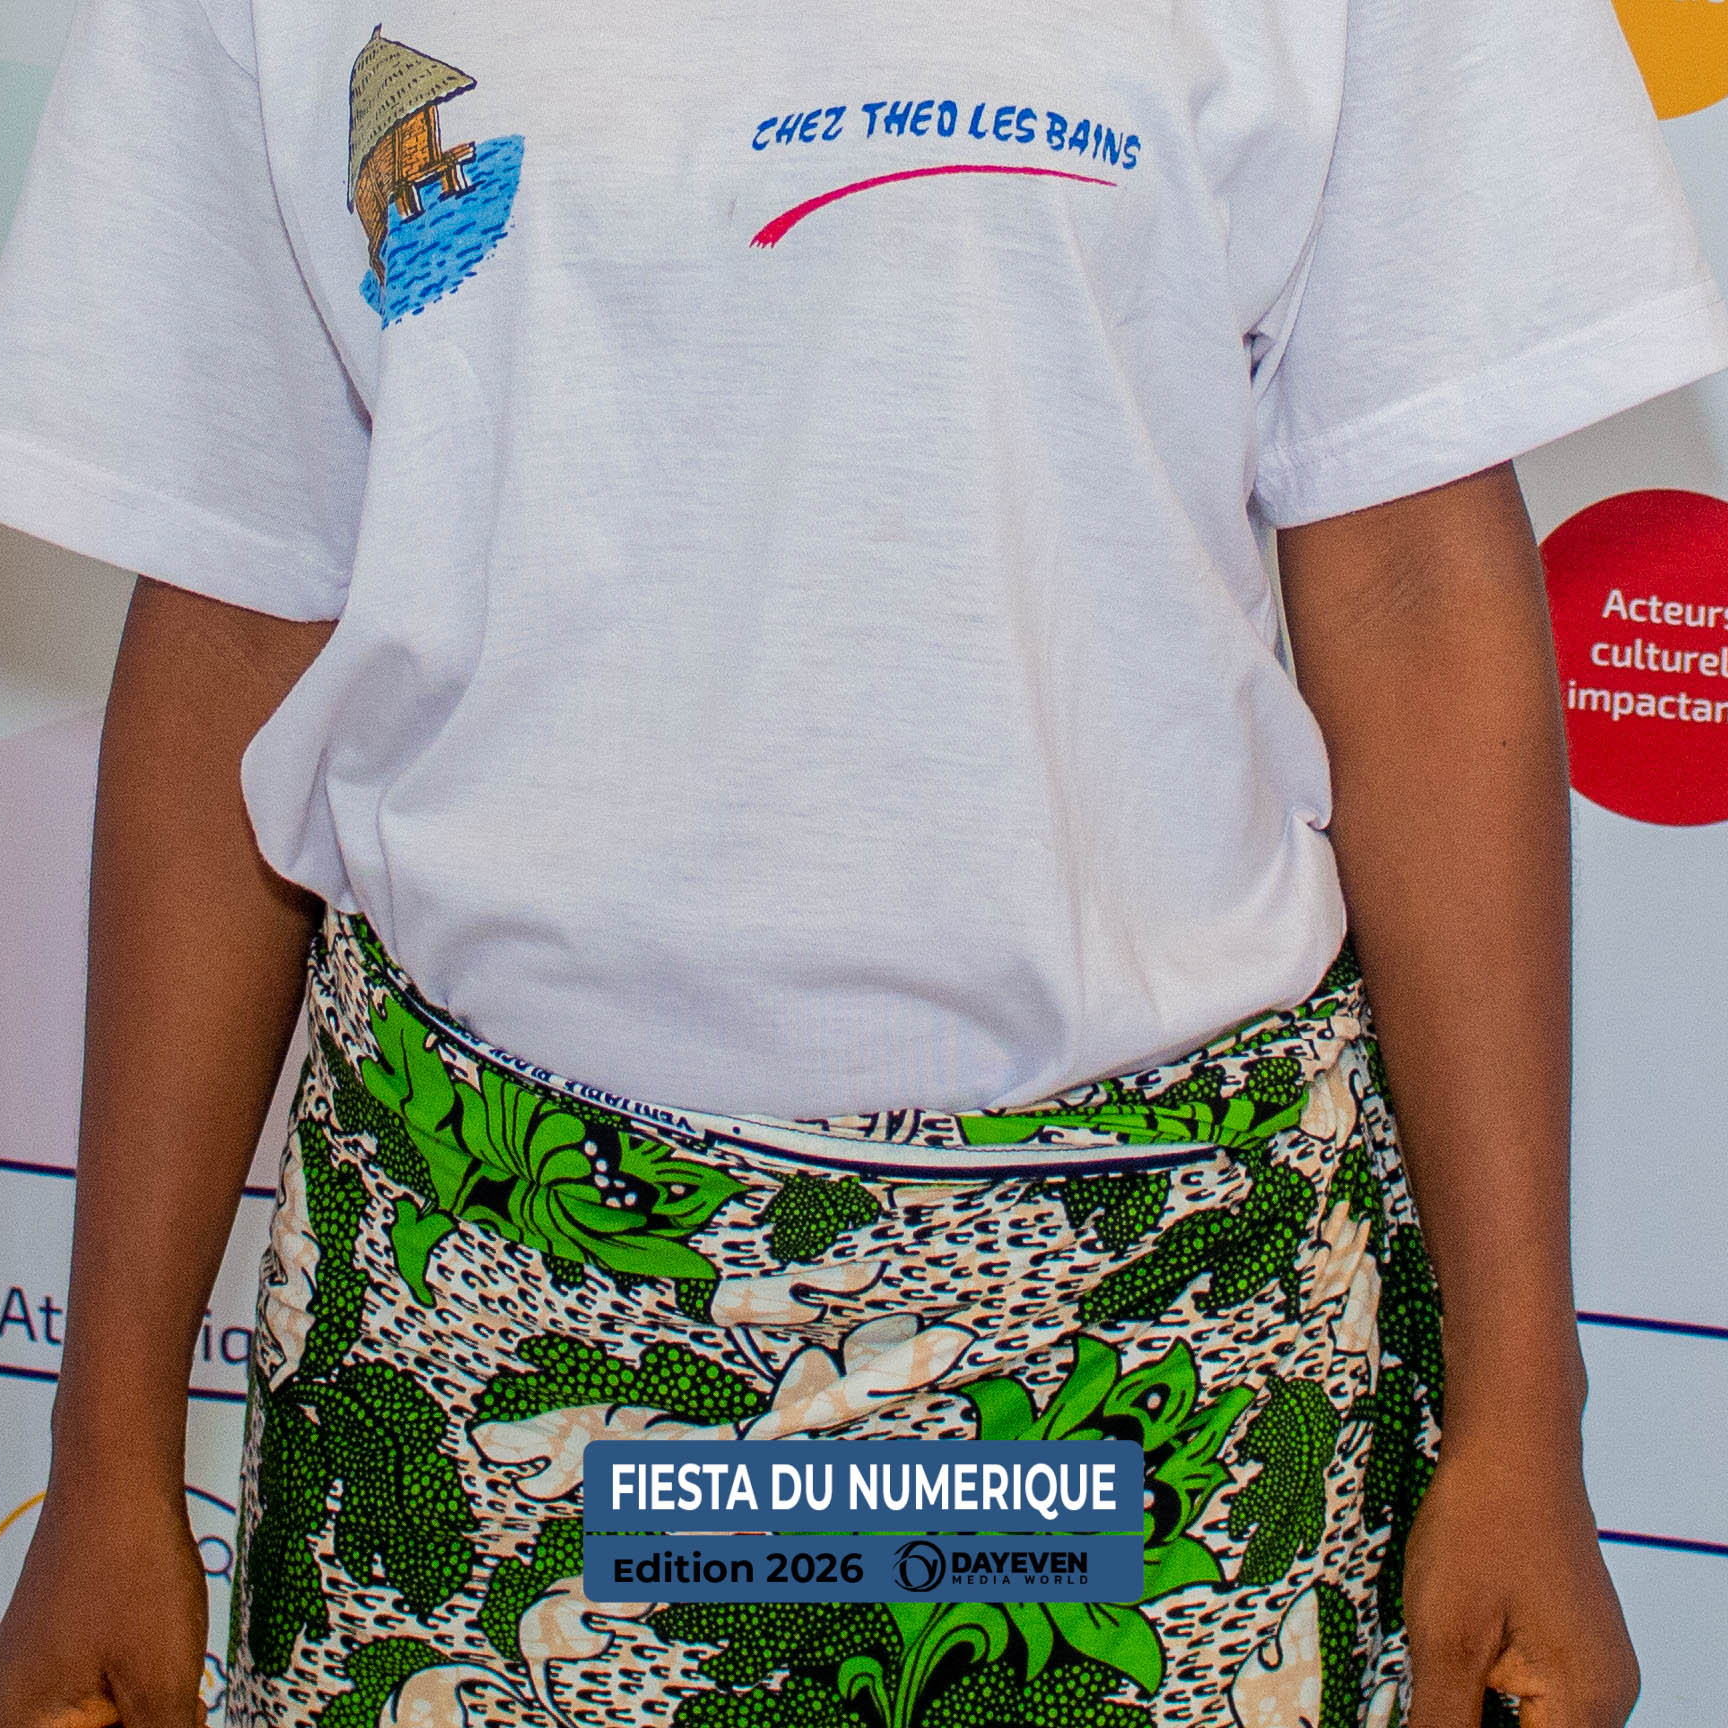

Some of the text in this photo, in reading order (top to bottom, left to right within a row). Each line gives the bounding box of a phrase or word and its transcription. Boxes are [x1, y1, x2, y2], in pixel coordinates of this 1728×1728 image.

[750, 99, 1142, 170] CHEZ THEO LES BAINS
